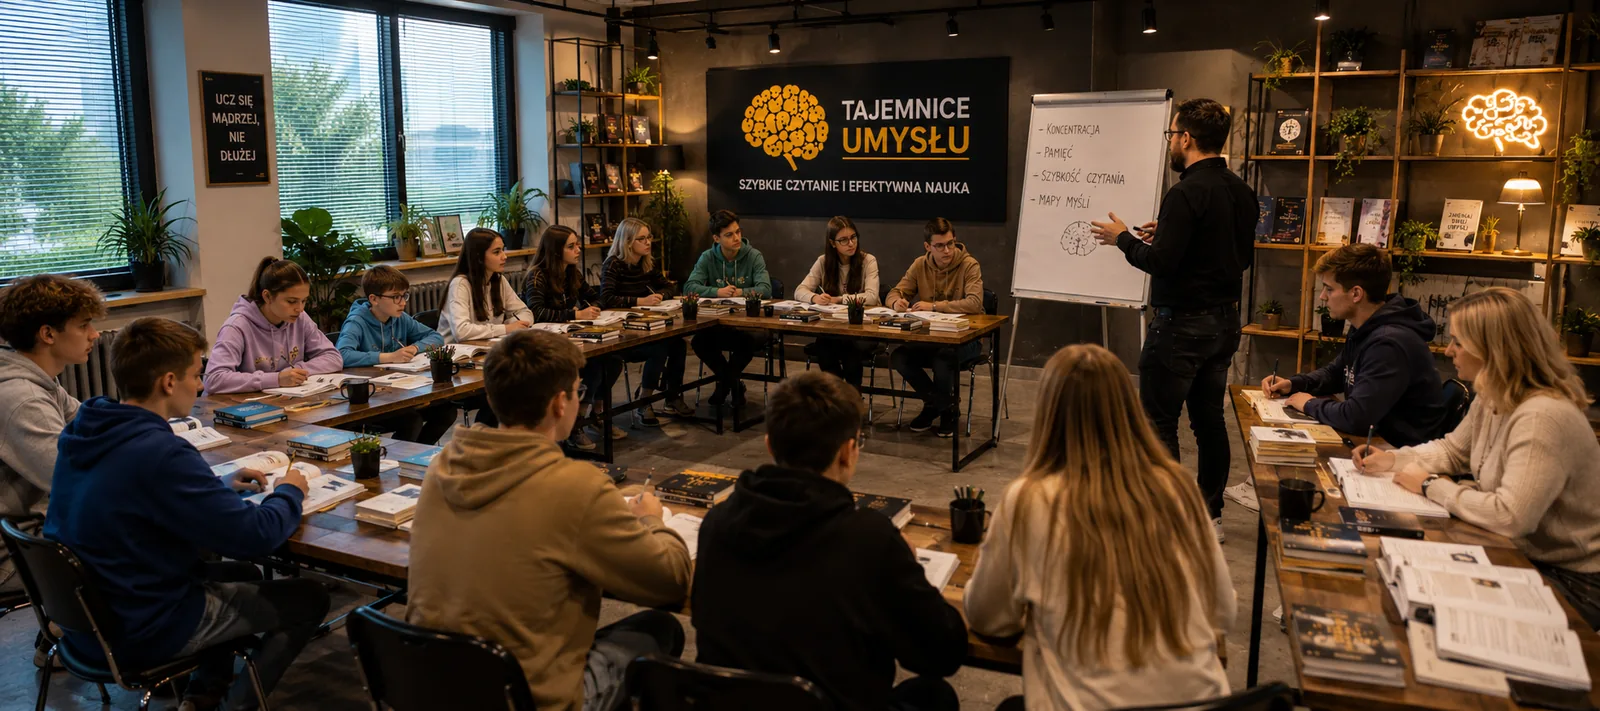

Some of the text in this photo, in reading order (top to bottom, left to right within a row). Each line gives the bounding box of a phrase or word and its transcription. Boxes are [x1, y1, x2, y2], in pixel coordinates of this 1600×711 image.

[215, 93, 253, 108] UCZ SIĘ
[841, 96, 970, 121] TAJEMNICE
[212, 112, 260, 126] MĄDRZEJ,
[229, 131, 246, 143] NIE
[842, 126, 970, 154] UMYSŁU
[220, 148, 256, 161] DŁUŻEJ
[1044, 144, 1074, 161] PAMIĘĆ
[1041, 168, 1081, 183] SZYBKOŚĆ
[739, 178, 970, 194] SZYBKIE CZYTANIE I EFEKTYWNA NAUKA
[1038, 194, 1061, 208] MAPY
